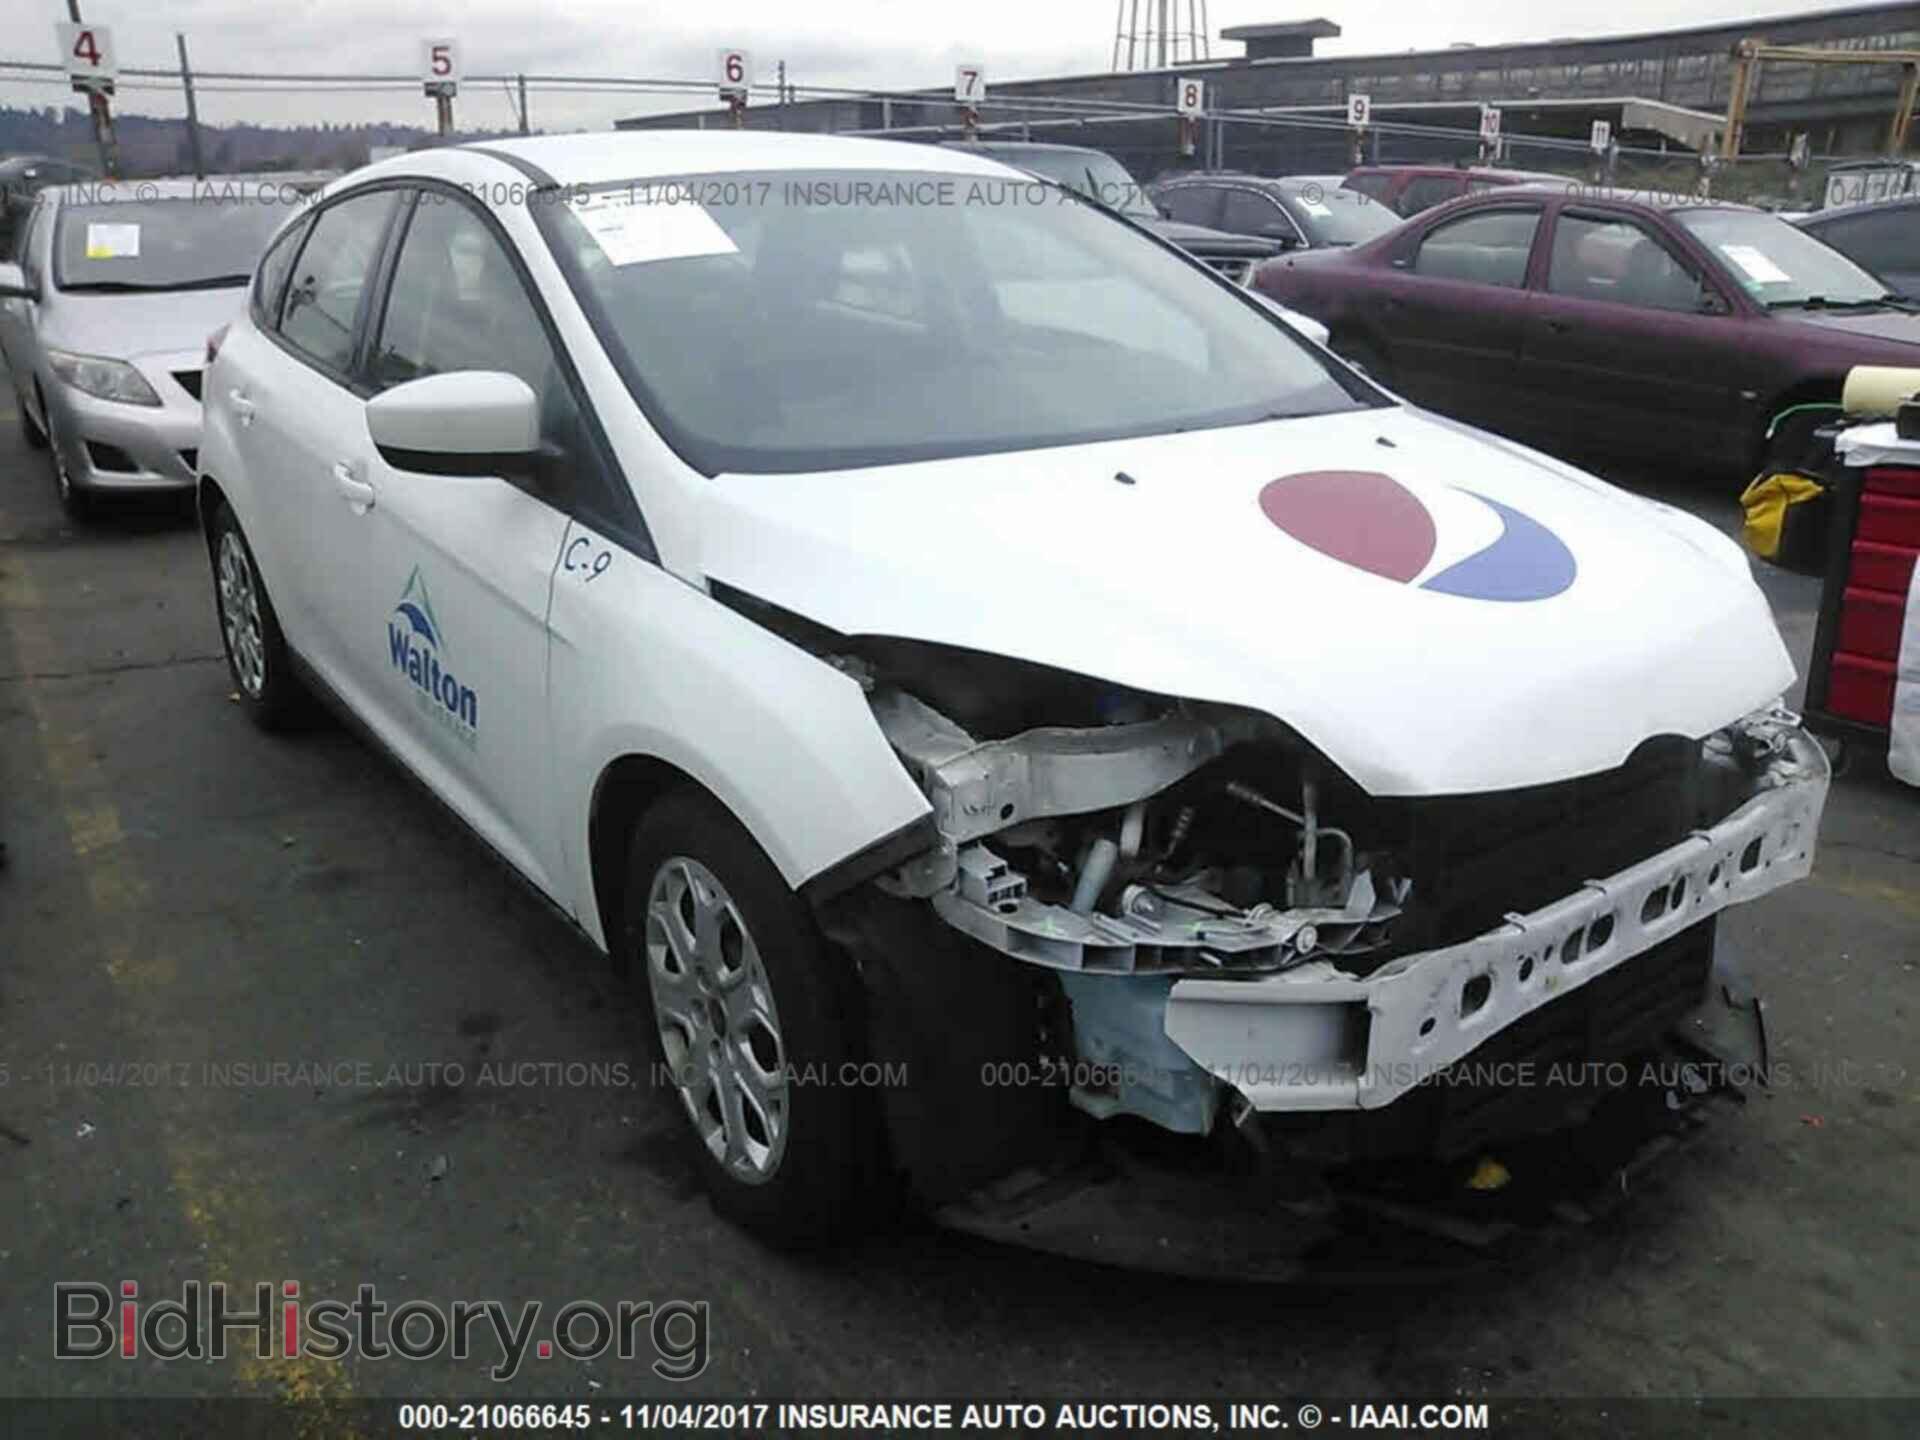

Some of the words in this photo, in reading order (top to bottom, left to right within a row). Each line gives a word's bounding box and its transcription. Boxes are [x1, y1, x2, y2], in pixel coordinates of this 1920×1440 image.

[73, 30, 101, 67] 4
[432, 46, 451, 76] 5
[726, 53, 743, 82] 6
[962, 71, 978, 96] 7
[1185, 84, 1197, 107] 8
[1353, 100, 1365, 121] 9
[1484, 112, 1498, 134] 10
[564, 537, 612, 582] C-9
[388, 622, 476, 728] Walton
